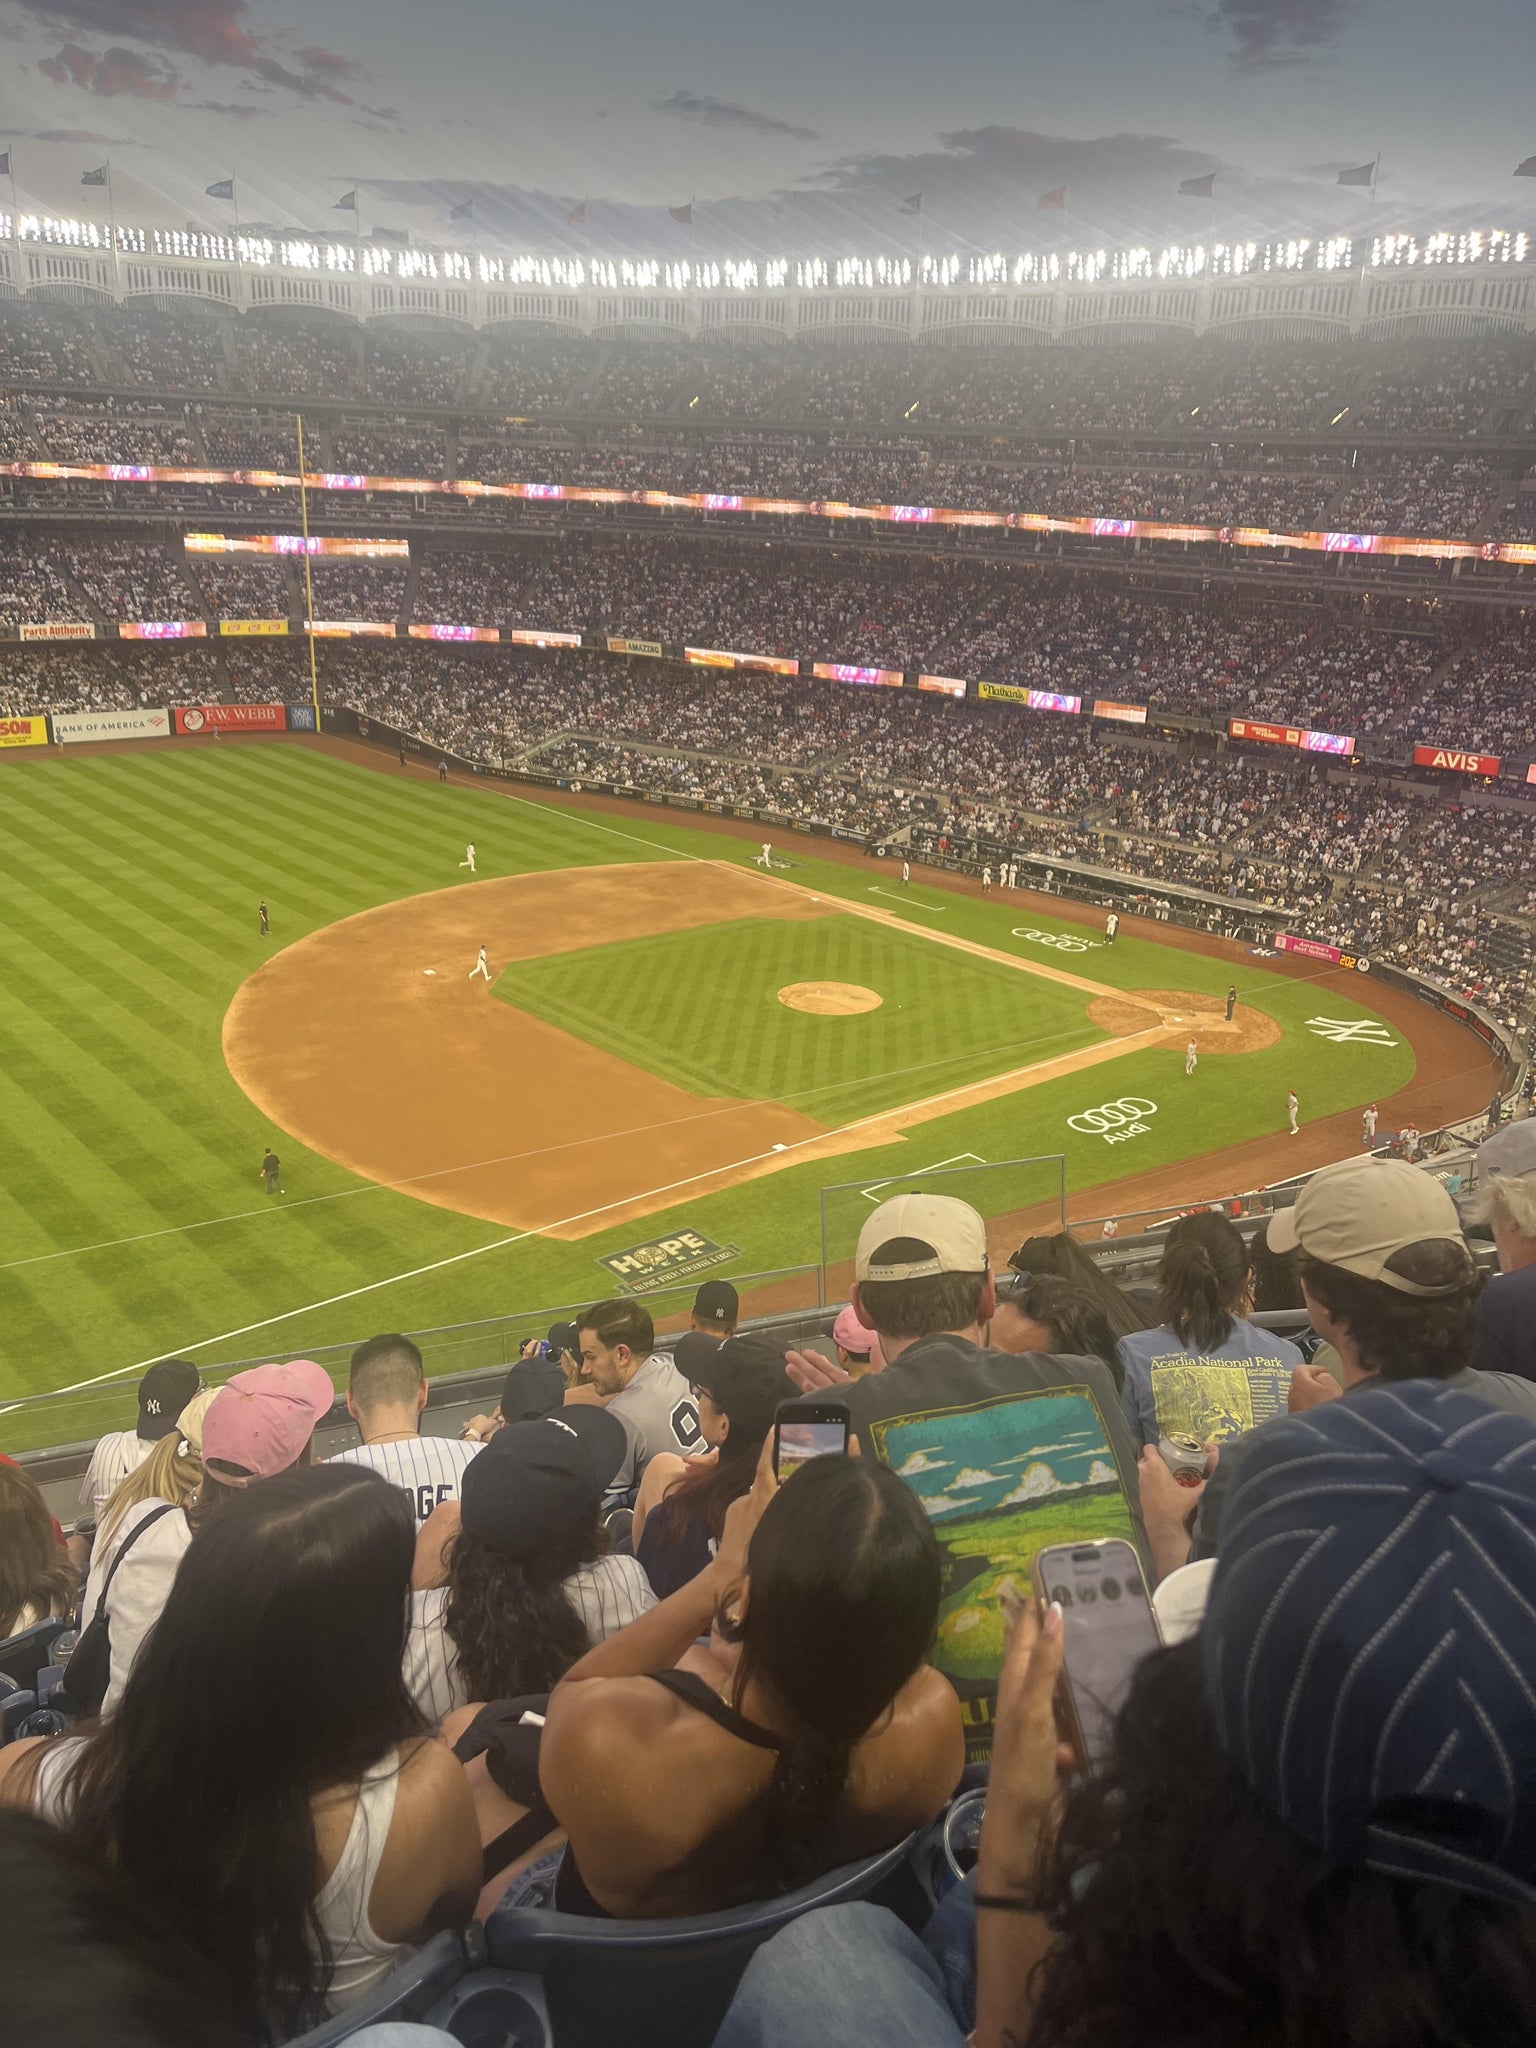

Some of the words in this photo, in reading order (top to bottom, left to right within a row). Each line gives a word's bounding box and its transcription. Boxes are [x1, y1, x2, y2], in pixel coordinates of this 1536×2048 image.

[713, 444, 744, 454] ASPEN
[830, 449, 864, 459] ASPEN
[23, 627, 48, 636] Parts
[49, 625, 91, 636] Authority
[628, 642, 660, 654] AMAZING
[206, 708, 231, 721] F.W.
[233, 707, 276, 720] WEBB
[55, 724, 84, 734] BANK
[86, 723, 98, 732] OF
[101, 720, 146, 731] AMERICA
[1431, 751, 1480, 772] AVIS
[1293, 944, 1307, 953] Best
[1307, 947, 1333, 960] Network
[1299, 940, 1330, 954] America's
[1339, 954, 1357, 968] 202
[1443, 999, 1468, 1020] Canon
[1102, 1121, 1153, 1146] Audi
[609, 1232, 706, 1274] HOPE
[657, 1270, 682, 1284] OTHERS
[1150, 1356, 1197, 1370] Acadia
[1198, 1355, 1254, 1369] National
[1254, 1356, 1284, 1368] Park
